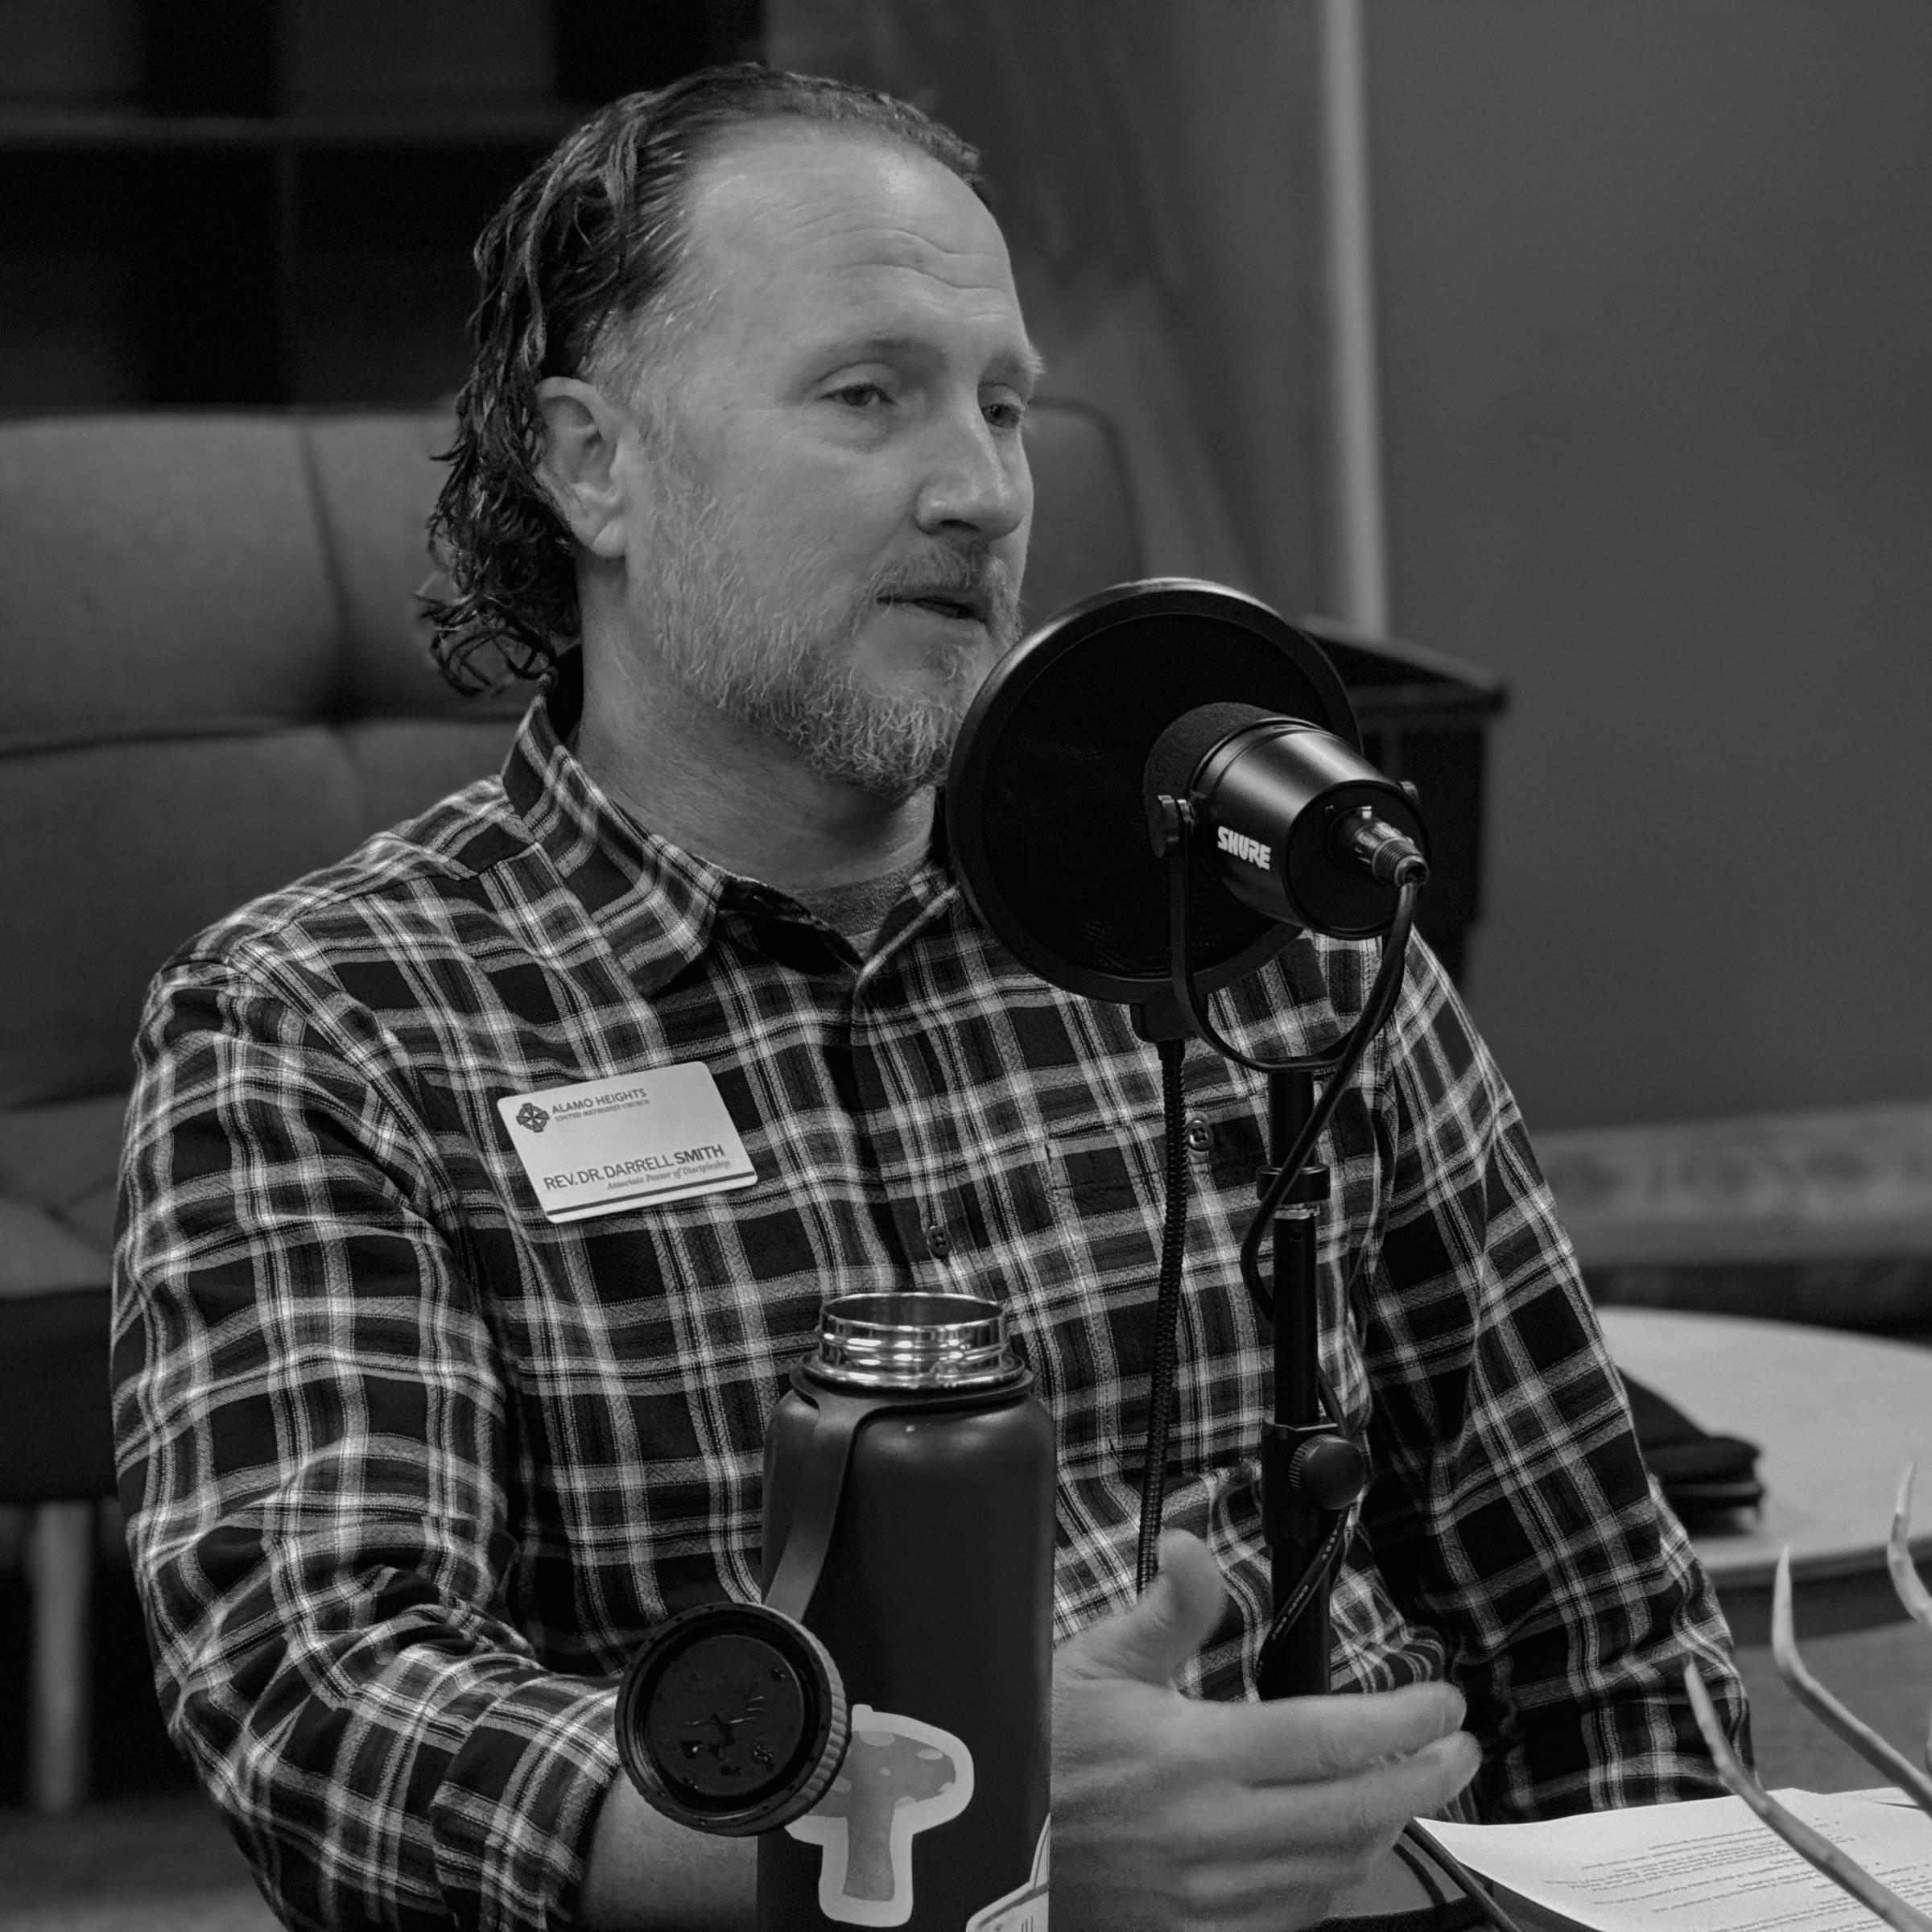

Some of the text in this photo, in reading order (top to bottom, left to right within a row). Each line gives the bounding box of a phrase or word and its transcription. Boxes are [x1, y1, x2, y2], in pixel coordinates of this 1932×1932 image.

[1217, 825, 1271, 870] SHURE
[552, 1088, 646, 1113] ALAMO HEIGHTS
[543, 1144, 724, 1190] REV. DR. DARRELL SMITH
